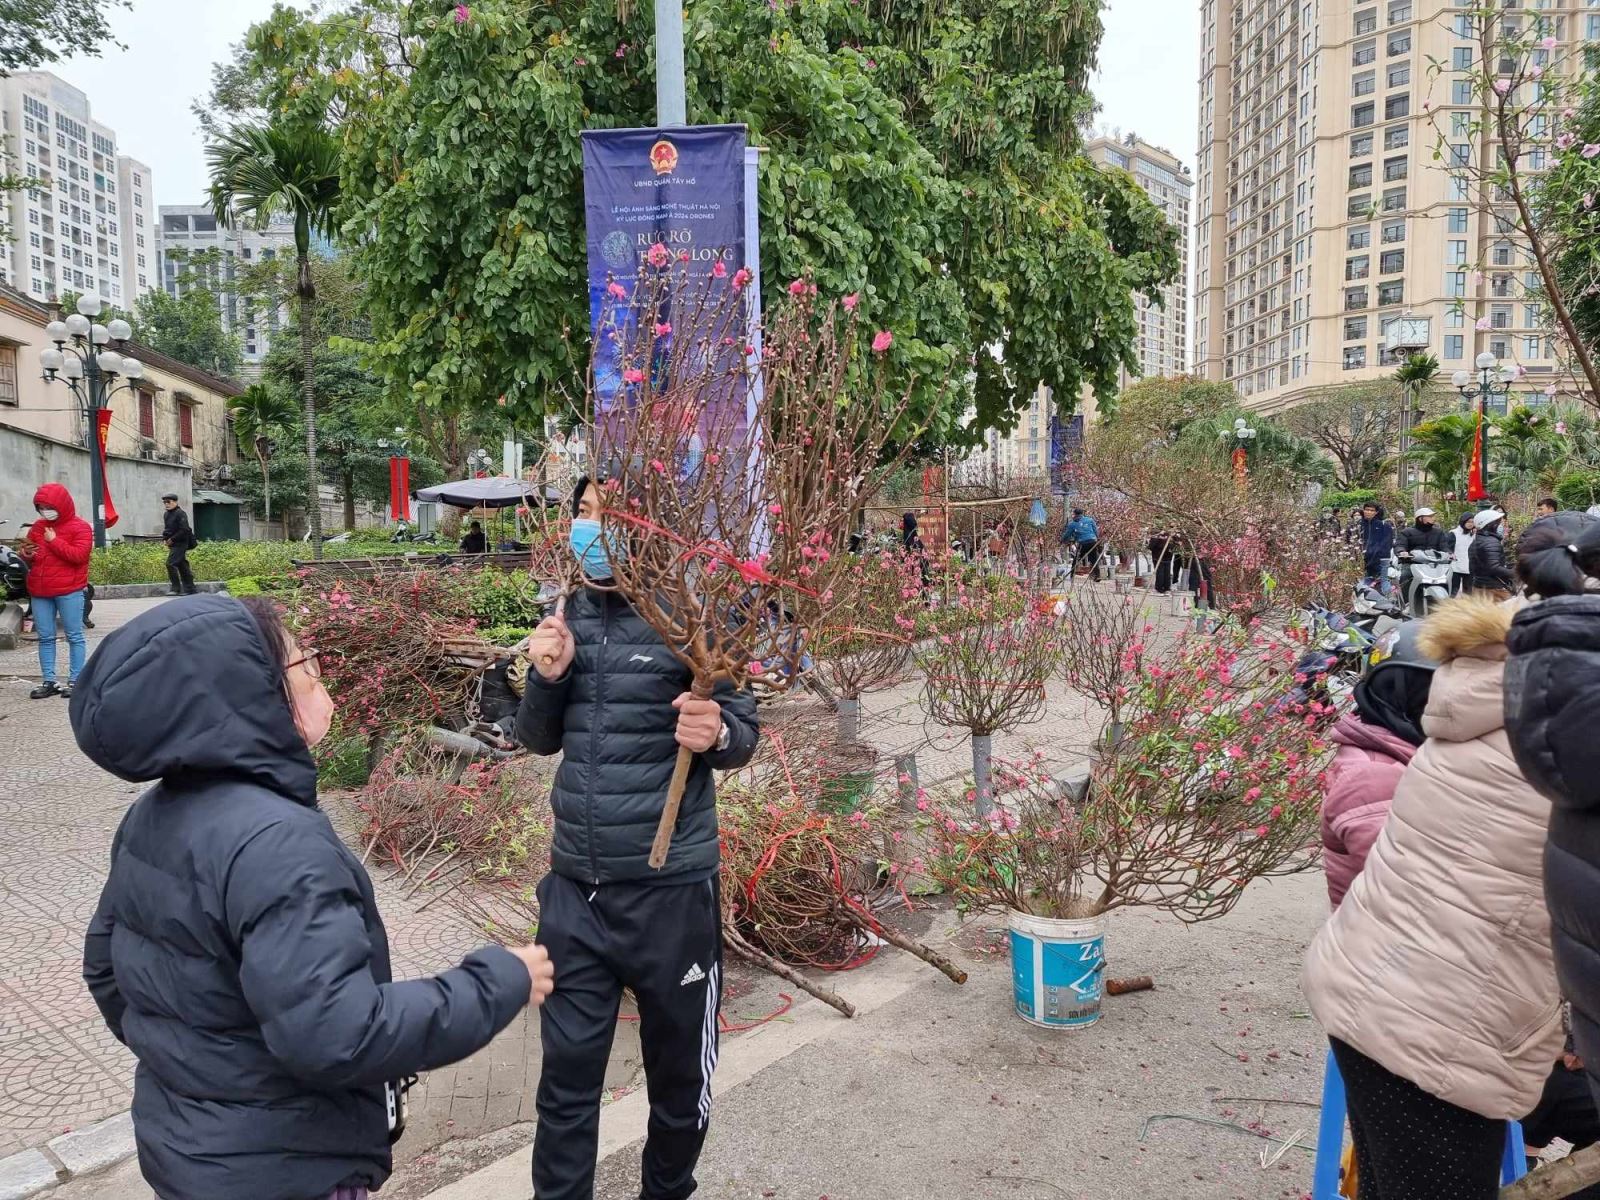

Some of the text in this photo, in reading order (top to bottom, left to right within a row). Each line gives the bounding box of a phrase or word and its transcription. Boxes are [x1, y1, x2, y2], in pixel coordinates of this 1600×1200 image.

[672, 177, 684, 185] TÂY
[692, 247, 733, 261] LONG
[680, 972, 705, 986] adidas
